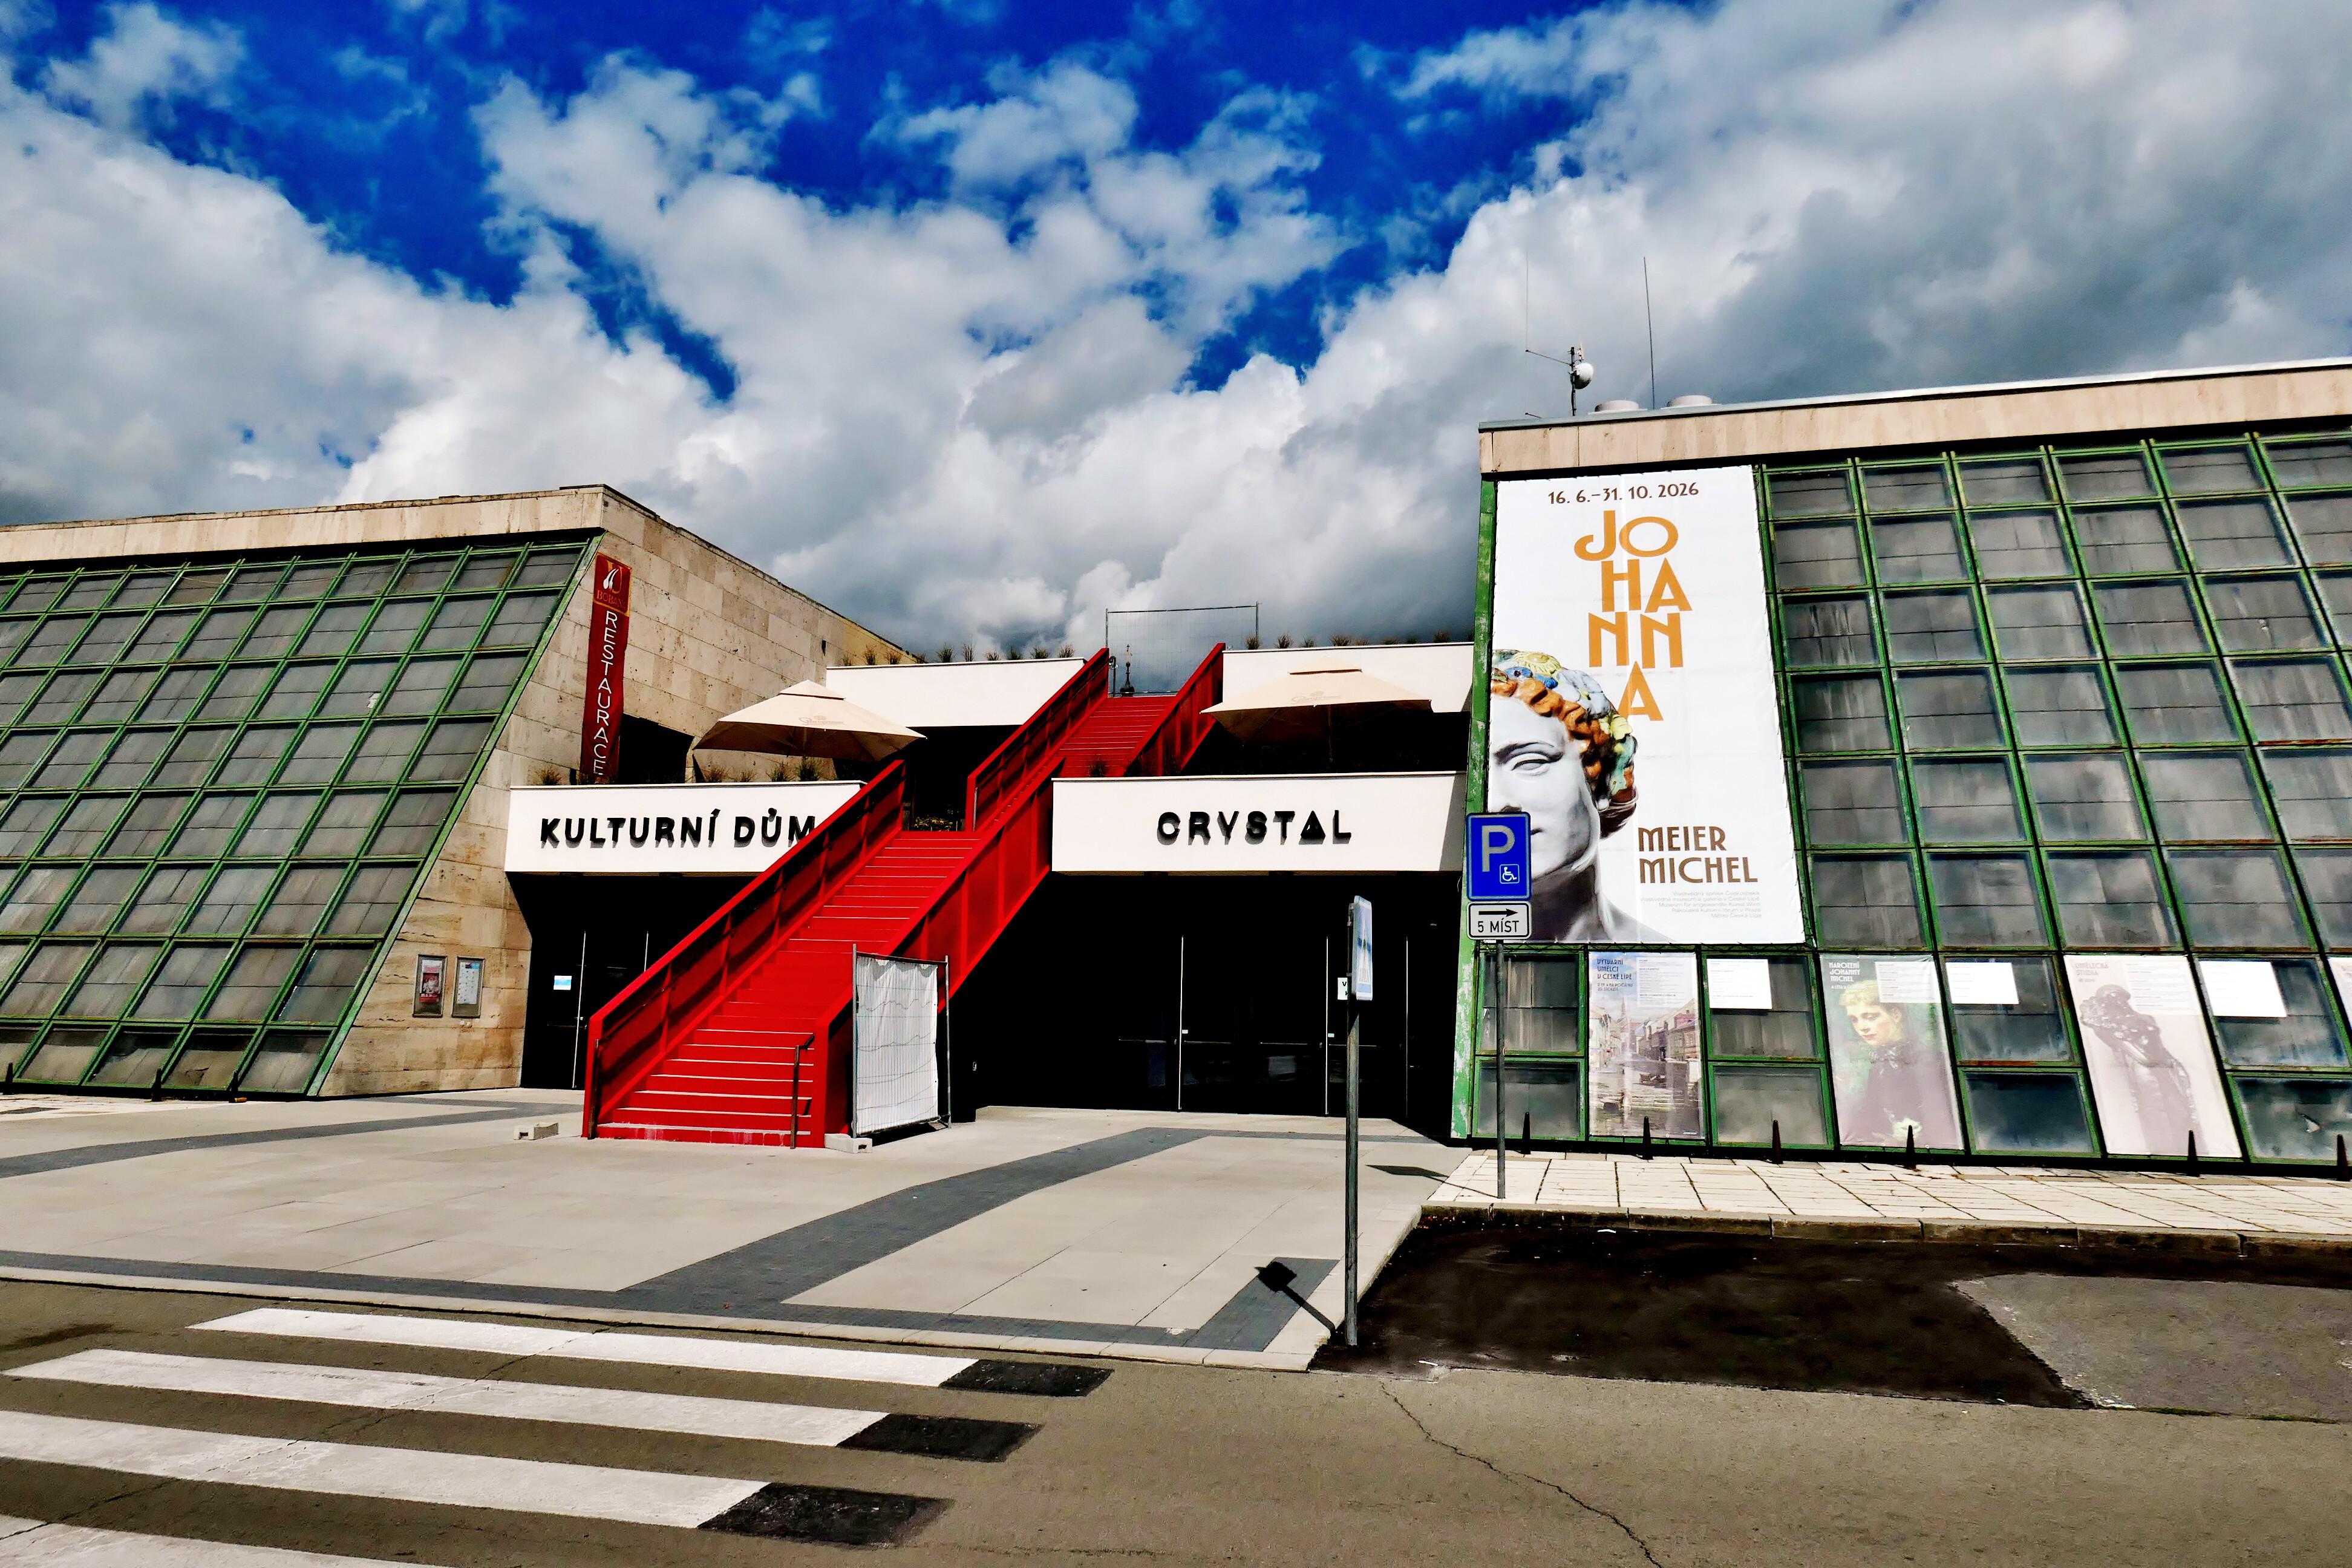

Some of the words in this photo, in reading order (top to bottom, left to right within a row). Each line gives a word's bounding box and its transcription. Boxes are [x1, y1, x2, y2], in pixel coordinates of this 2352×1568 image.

[1548, 491, 1570, 505] 16.
[1628, 485, 1652, 500] 10.
[1658, 482, 1699, 498] 2026
[1573, 510, 1679, 561] JO
[1601, 558, 1693, 613] HA
[1587, 611, 1684, 669] NN
[593, 610, 618, 776] RESTAURACE
[1617, 661, 1664, 722] A
[541, 808, 721, 846] KULTURNÍ
[734, 808, 815, 846] DŮM
[1157, 810, 1351, 844] CRYSTAL
[1638, 825, 1727, 852] MEIER
[1481, 825, 1515, 872] P
[1639, 856, 1759, 884] MICHEL
[1478, 921, 1484, 933] 5
[1490, 918, 1520, 933] MÍST
